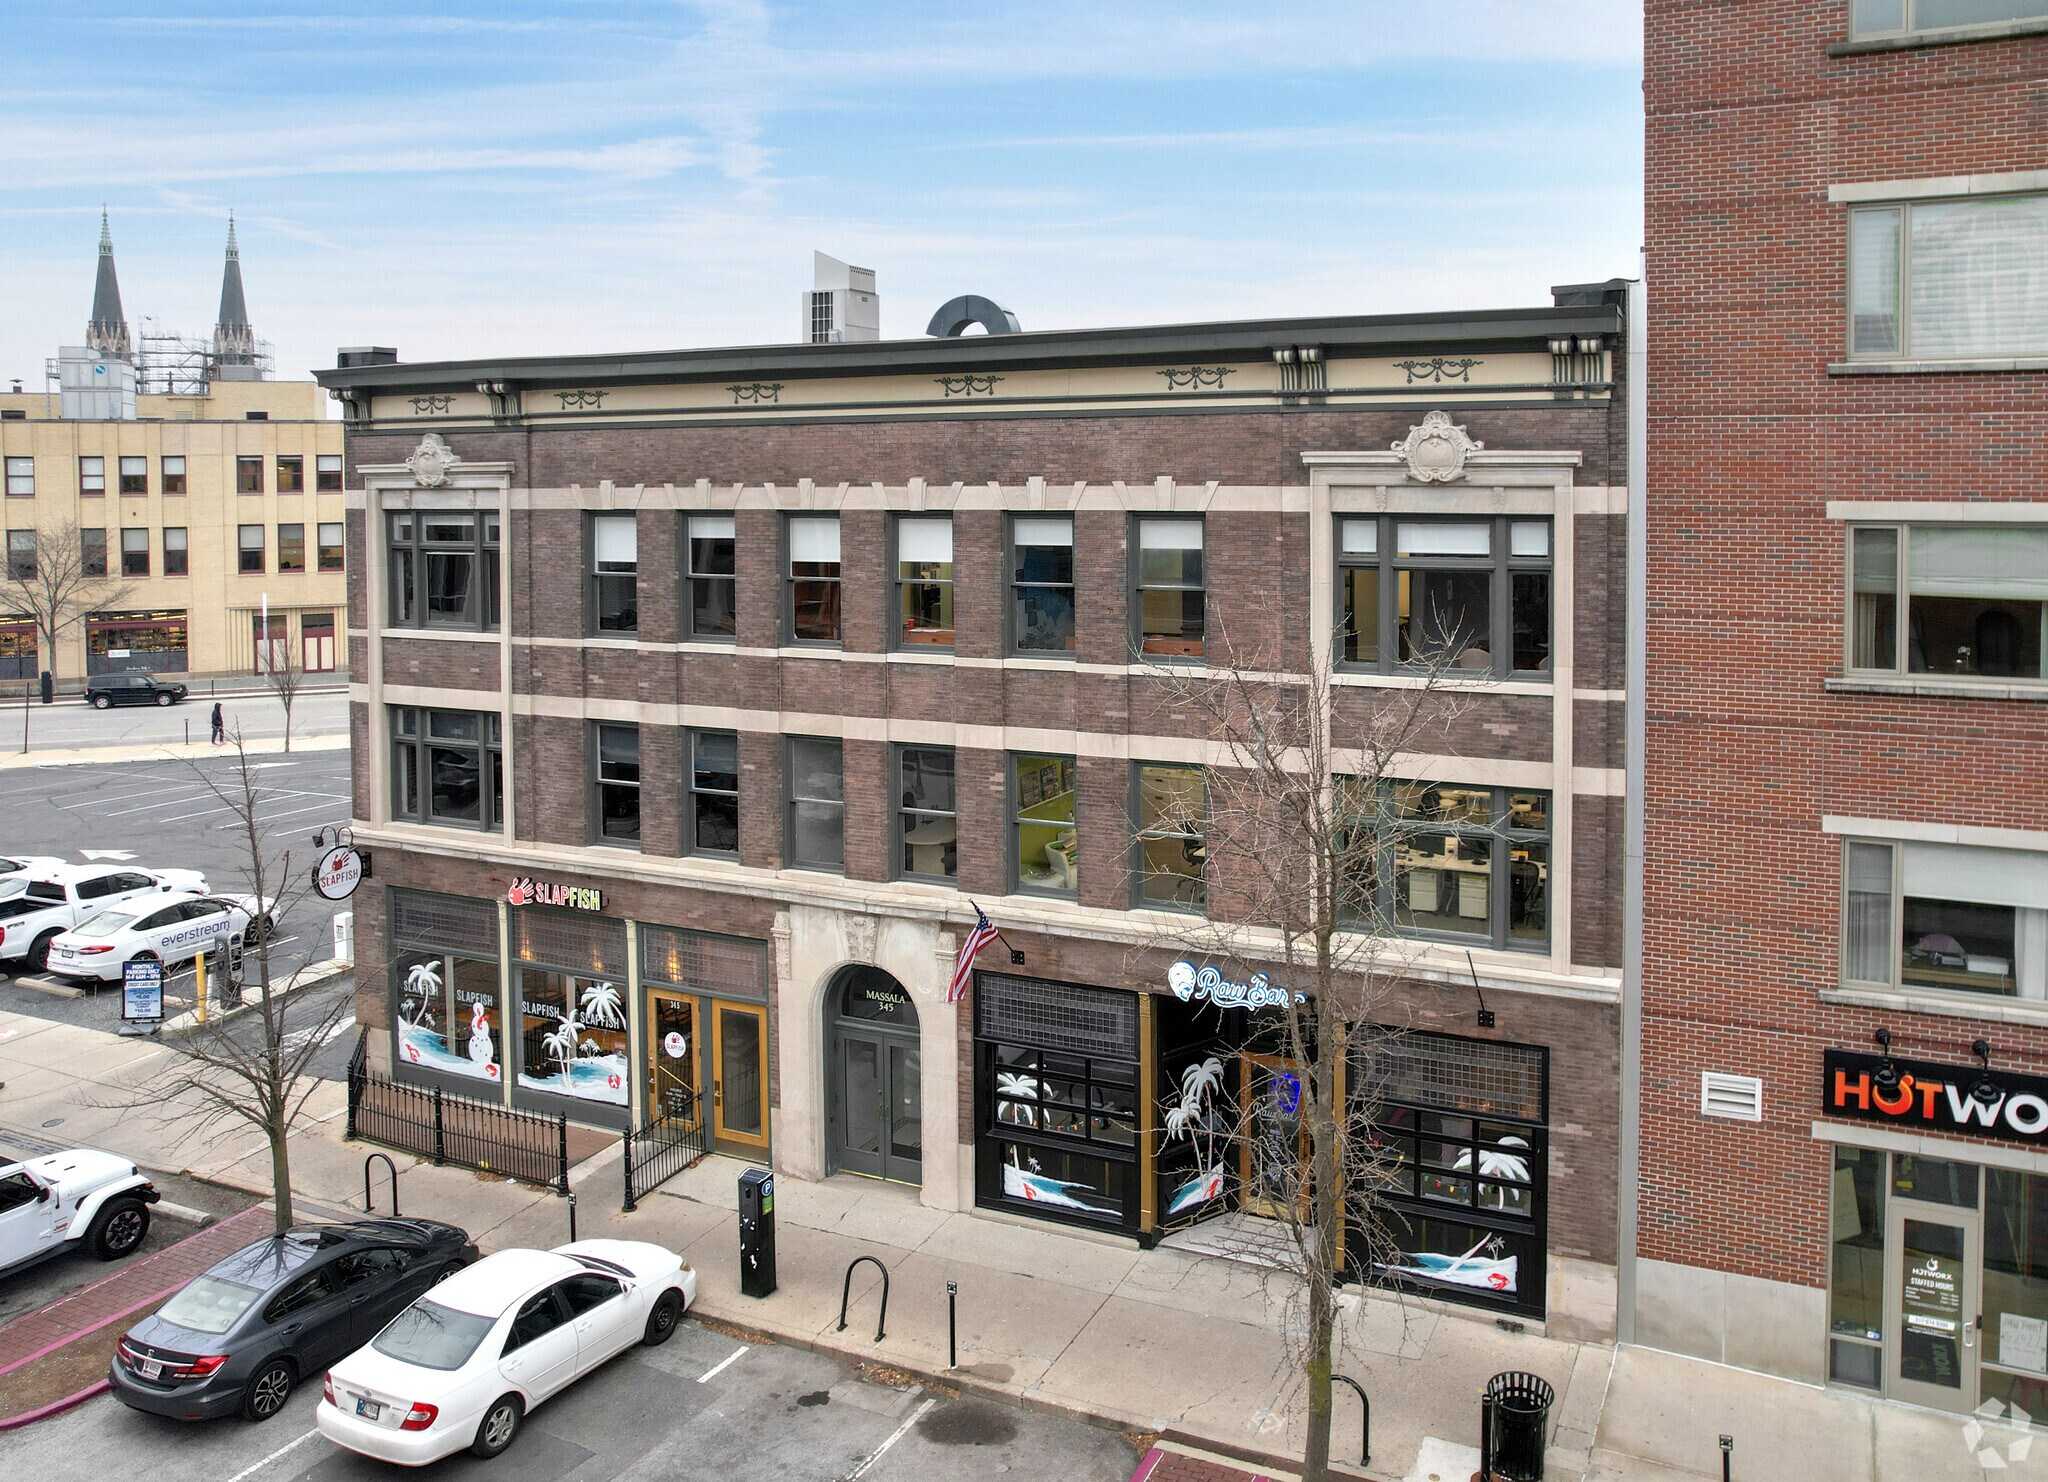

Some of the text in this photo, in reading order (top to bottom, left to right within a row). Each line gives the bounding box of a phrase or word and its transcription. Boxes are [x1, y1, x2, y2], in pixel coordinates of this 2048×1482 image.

[321, 868, 359, 889] SLAPFISH
[535, 882, 601, 911] SLAPFISH
[162, 920, 230, 947] everstream
[866, 989, 906, 1004] MASSALA
[1195, 967, 1306, 1011] Raw Bar
[456, 989, 493, 1007] SLAPFISH
[670, 1000, 680, 1009] 345
[522, 1000, 560, 1019] SLAPFISH
[878, 1001, 894, 1012] 345
[764, 1182, 772, 1194] P
[1912, 1268, 1952, 1280] HOTWORX
[1911, 1277, 1954, 1292] STAFFED HOURS
